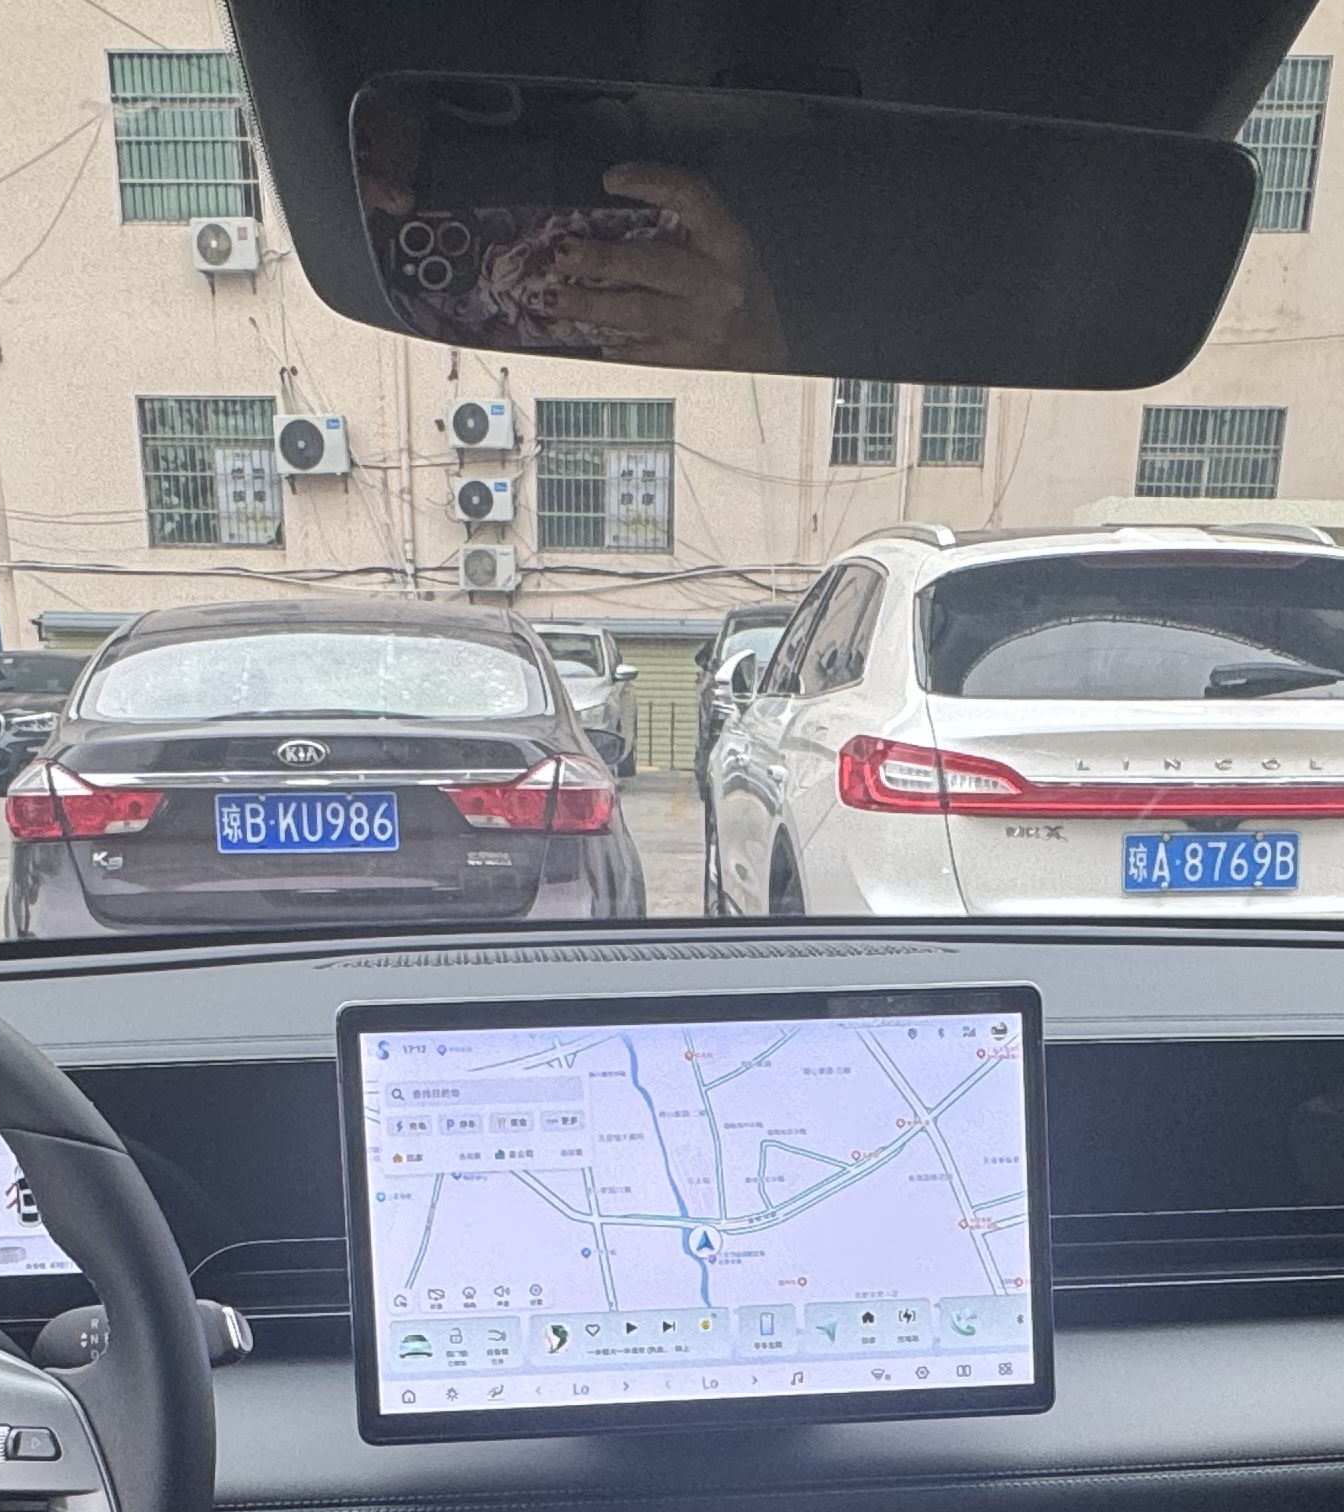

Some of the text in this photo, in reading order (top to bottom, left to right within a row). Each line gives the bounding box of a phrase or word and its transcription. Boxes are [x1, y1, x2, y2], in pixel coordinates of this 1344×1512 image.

[285, 746, 319, 762] KIA
[90, 1318, 100, 1329] R
[90, 1333, 100, 1345] N
[573, 1383, 590, 1396] Lo
[701, 1376, 719, 1390] Lo
